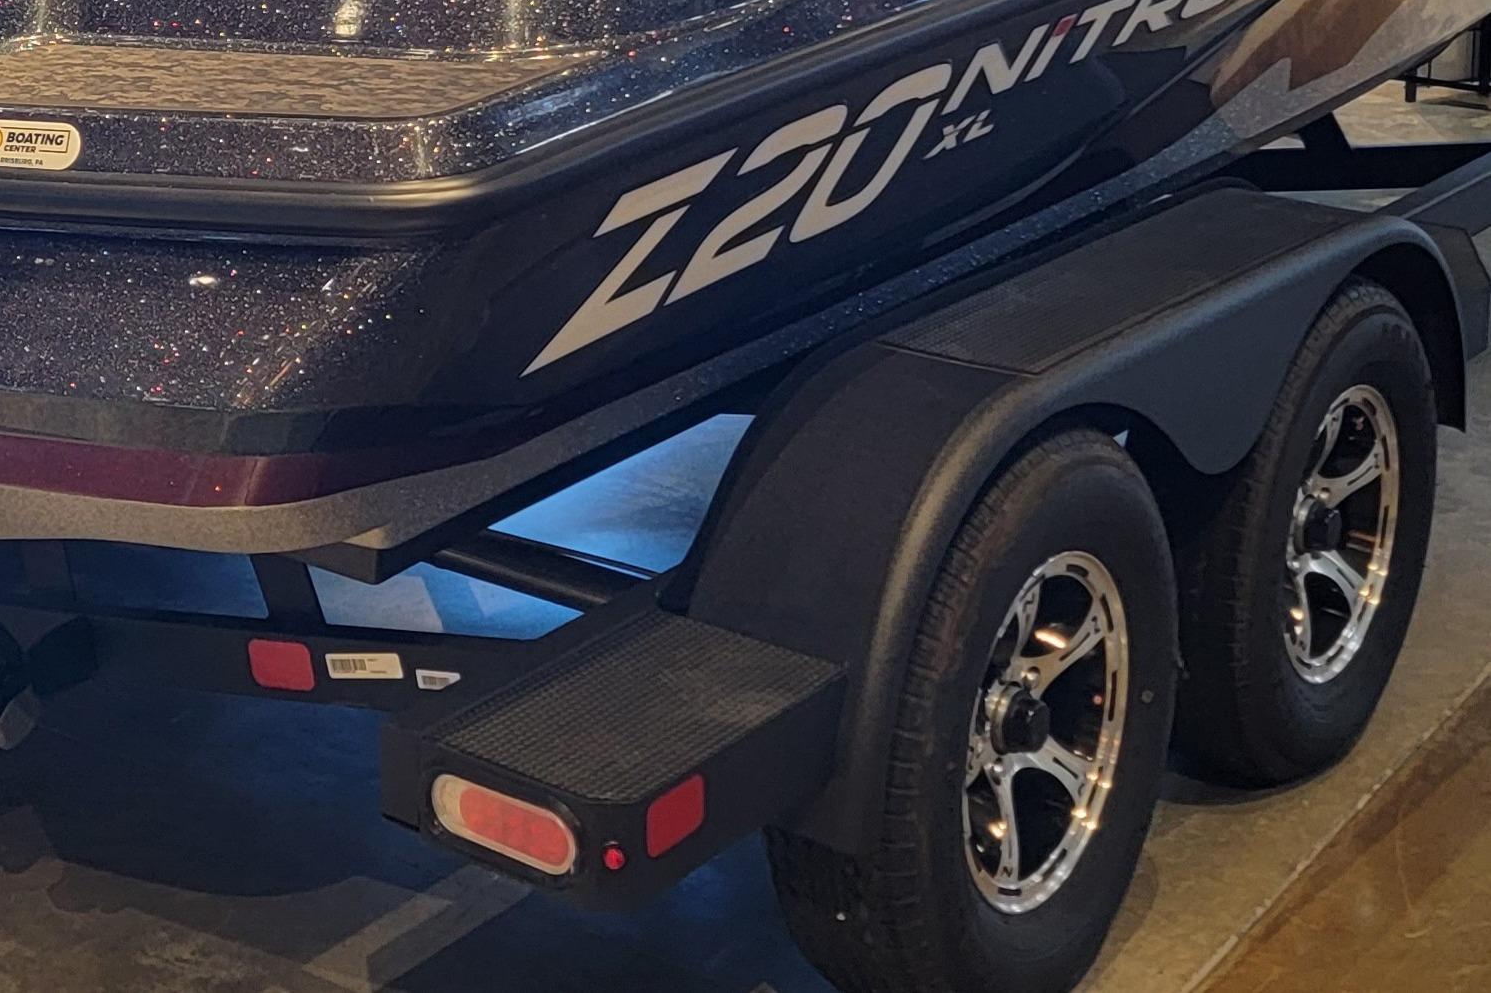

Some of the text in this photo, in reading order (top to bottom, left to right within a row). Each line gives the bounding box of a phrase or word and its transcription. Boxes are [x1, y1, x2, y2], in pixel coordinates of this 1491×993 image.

[4, 144, 37, 153] CENTER
[6, 132, 64, 146] BOATING
[924, 109, 996, 160] XL
[520, 62, 952, 377] Z20
